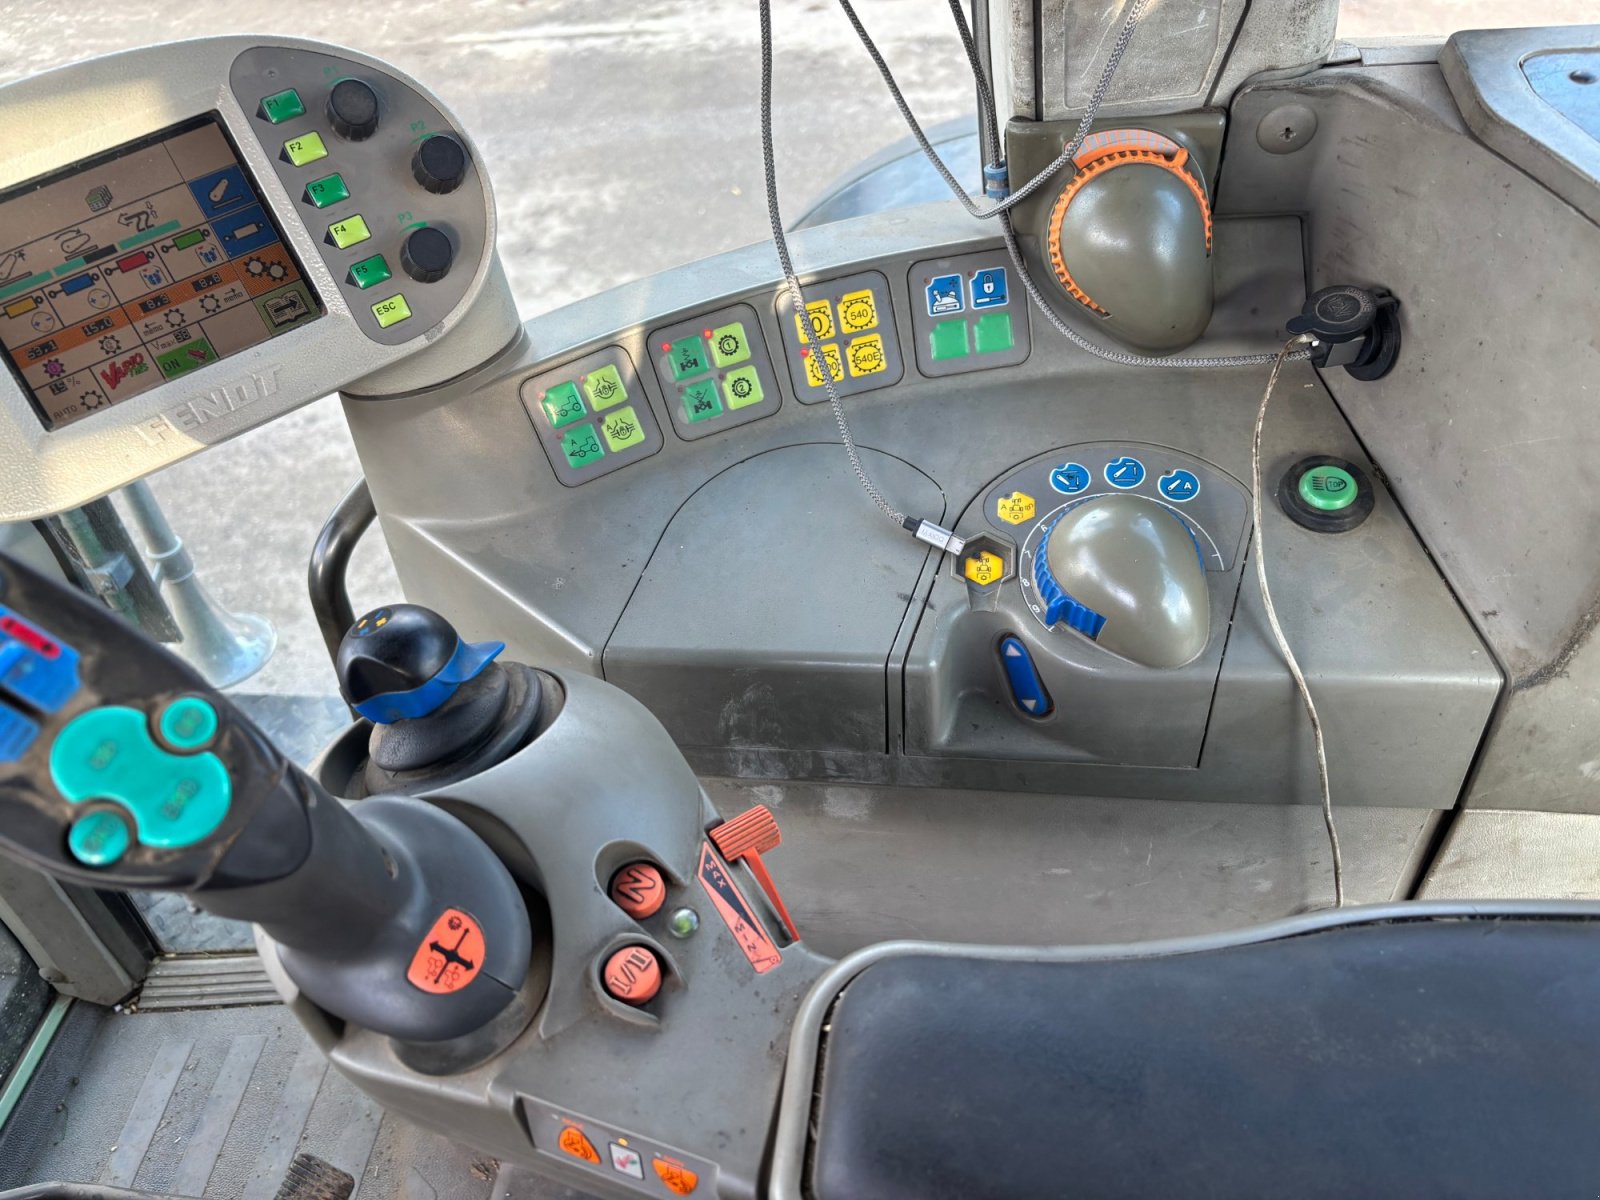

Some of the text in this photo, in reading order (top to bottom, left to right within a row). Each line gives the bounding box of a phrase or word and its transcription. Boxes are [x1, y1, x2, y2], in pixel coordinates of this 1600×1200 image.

[323, 65, 339, 76] P1
[266, 99, 280, 110] F1
[410, 120, 426, 132] P2
[289, 141, 303, 152] F2
[311, 183, 325, 195] F3
[397, 210, 413, 224] P3
[333, 224, 347, 236] F4
[355, 265, 368, 276] F5
[375, 301, 396, 316] ESC
[850, 308, 869, 321] 540
[811, 316, 823, 333] 0
[855, 351, 880, 365] 540E
[162, 358, 181, 373] ON
[133, 363, 285, 447] FENDT
[53, 405, 78, 420] AUTO
[1329, 480, 1346, 489] TOP
[705, 860, 727, 889] MAX
[735, 923, 757, 952] MIN
